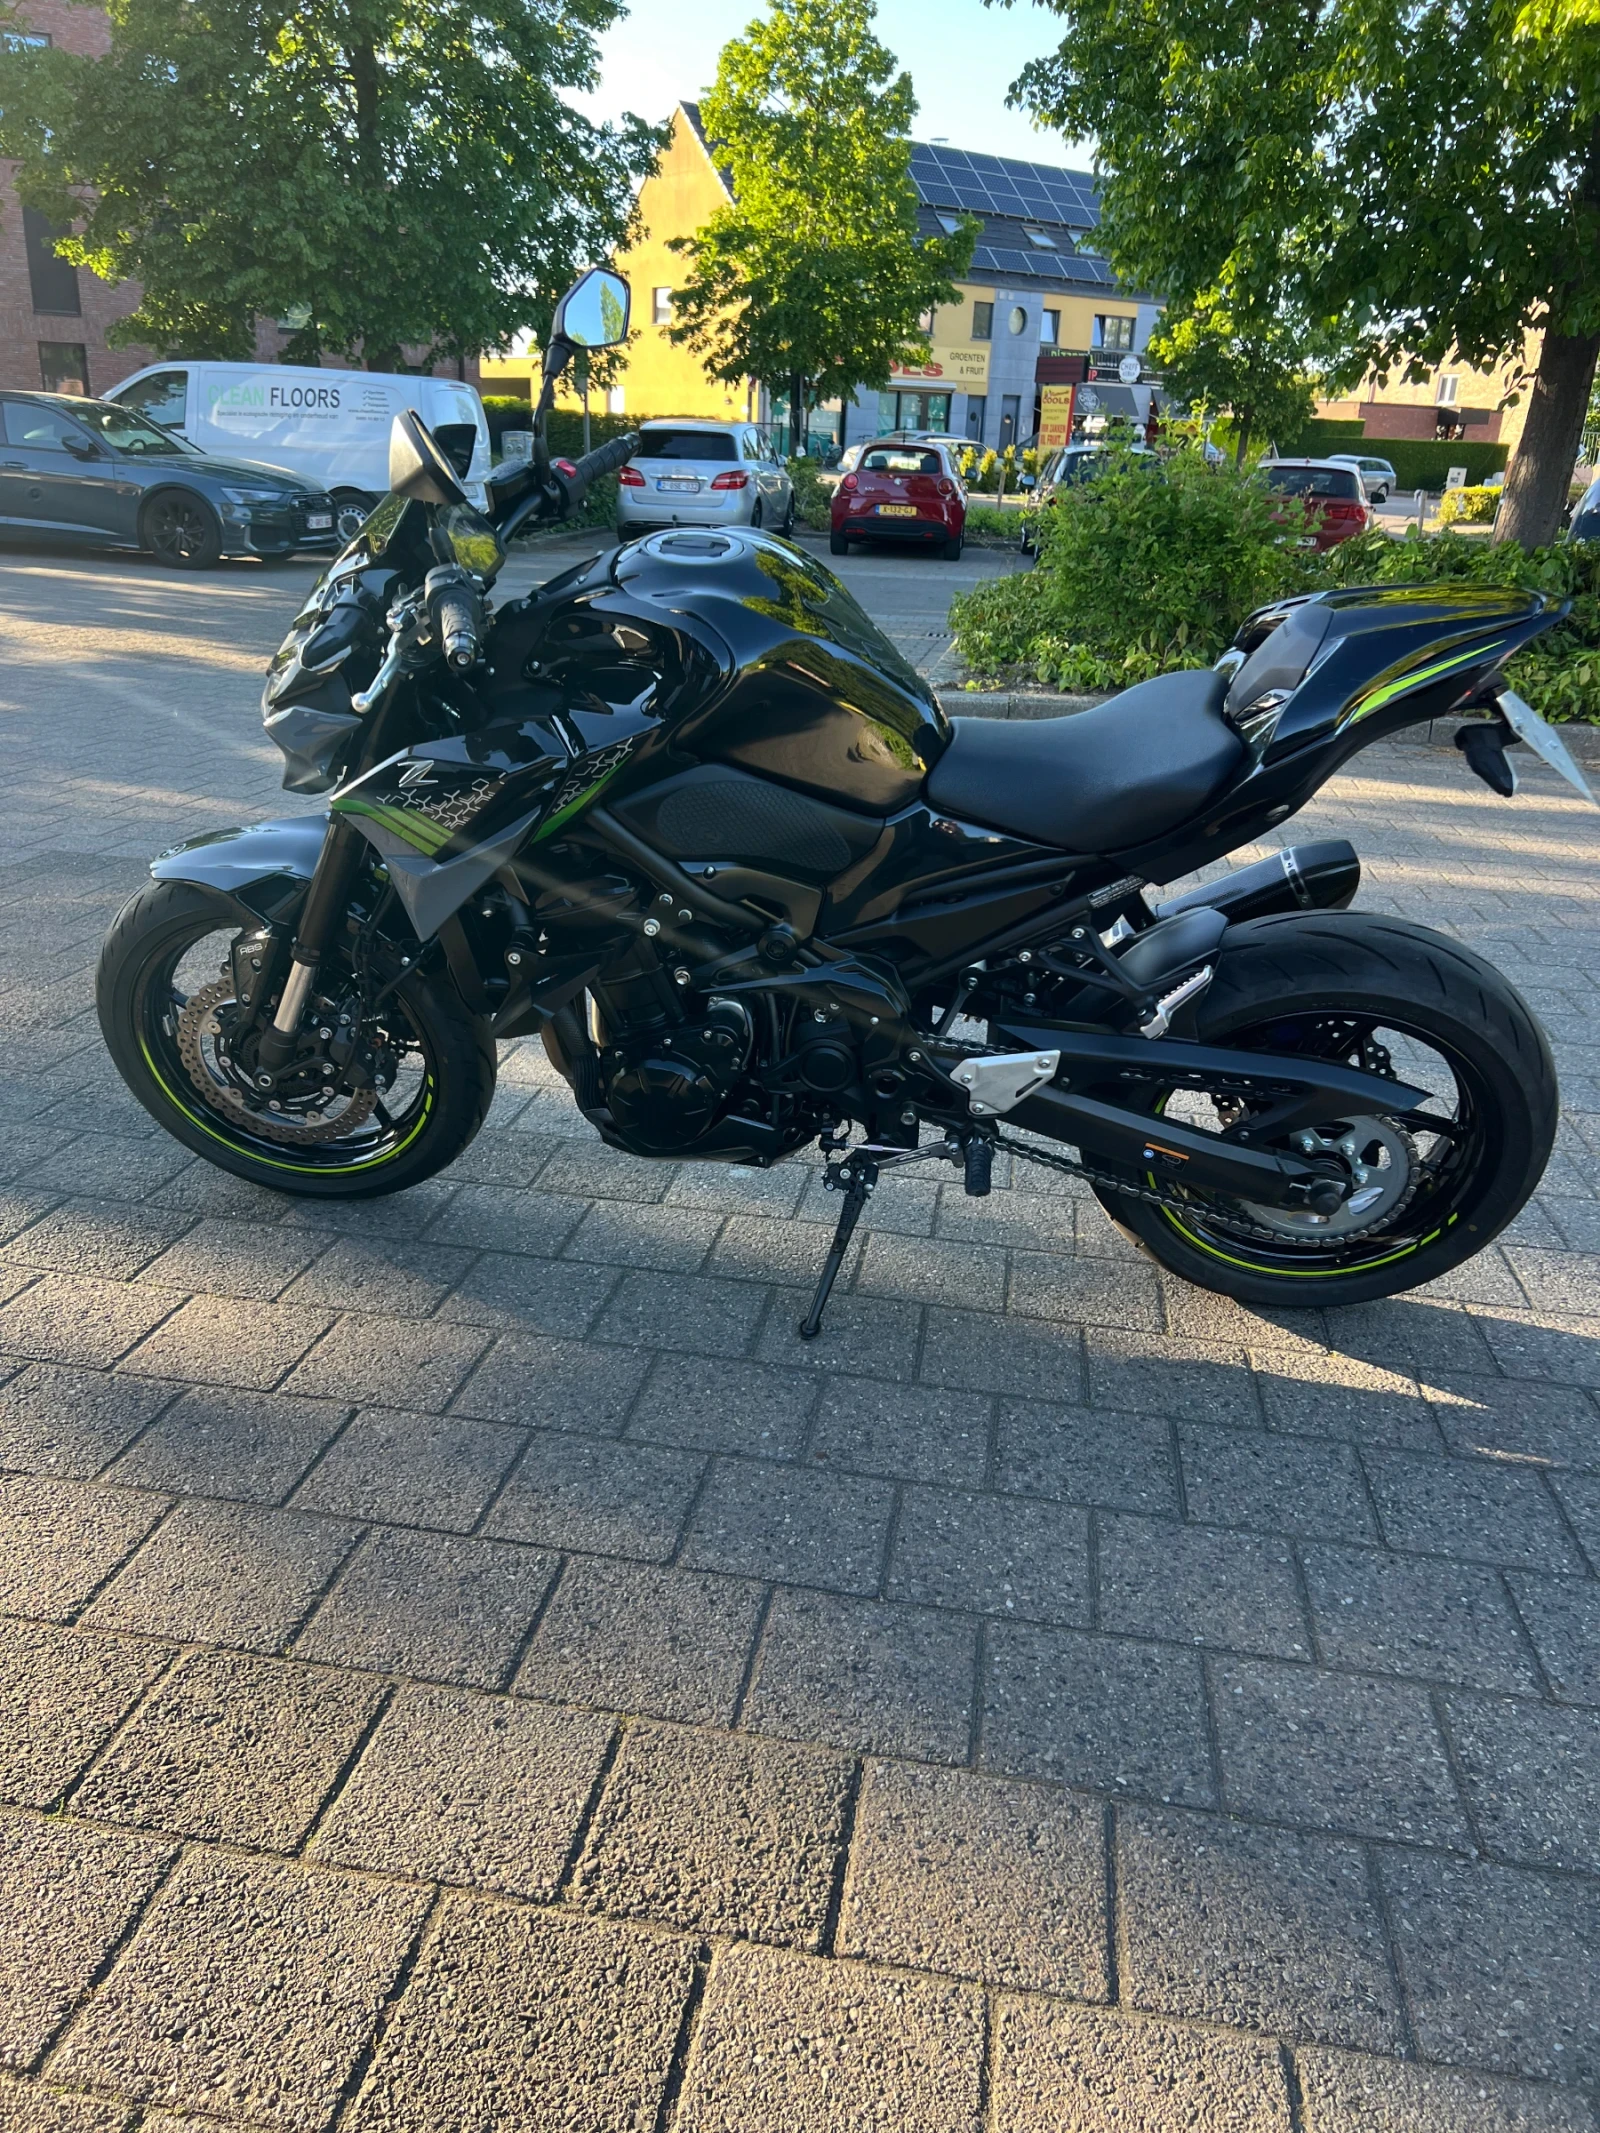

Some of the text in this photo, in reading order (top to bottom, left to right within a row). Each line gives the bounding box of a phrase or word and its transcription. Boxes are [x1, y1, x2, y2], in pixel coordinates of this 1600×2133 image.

[950, 352, 985, 362] GROENTEN
[966, 367, 985, 375] FRUIT
[207, 384, 341, 408] CLEAN FLOORS
[240, 943, 263, 955] ABS
